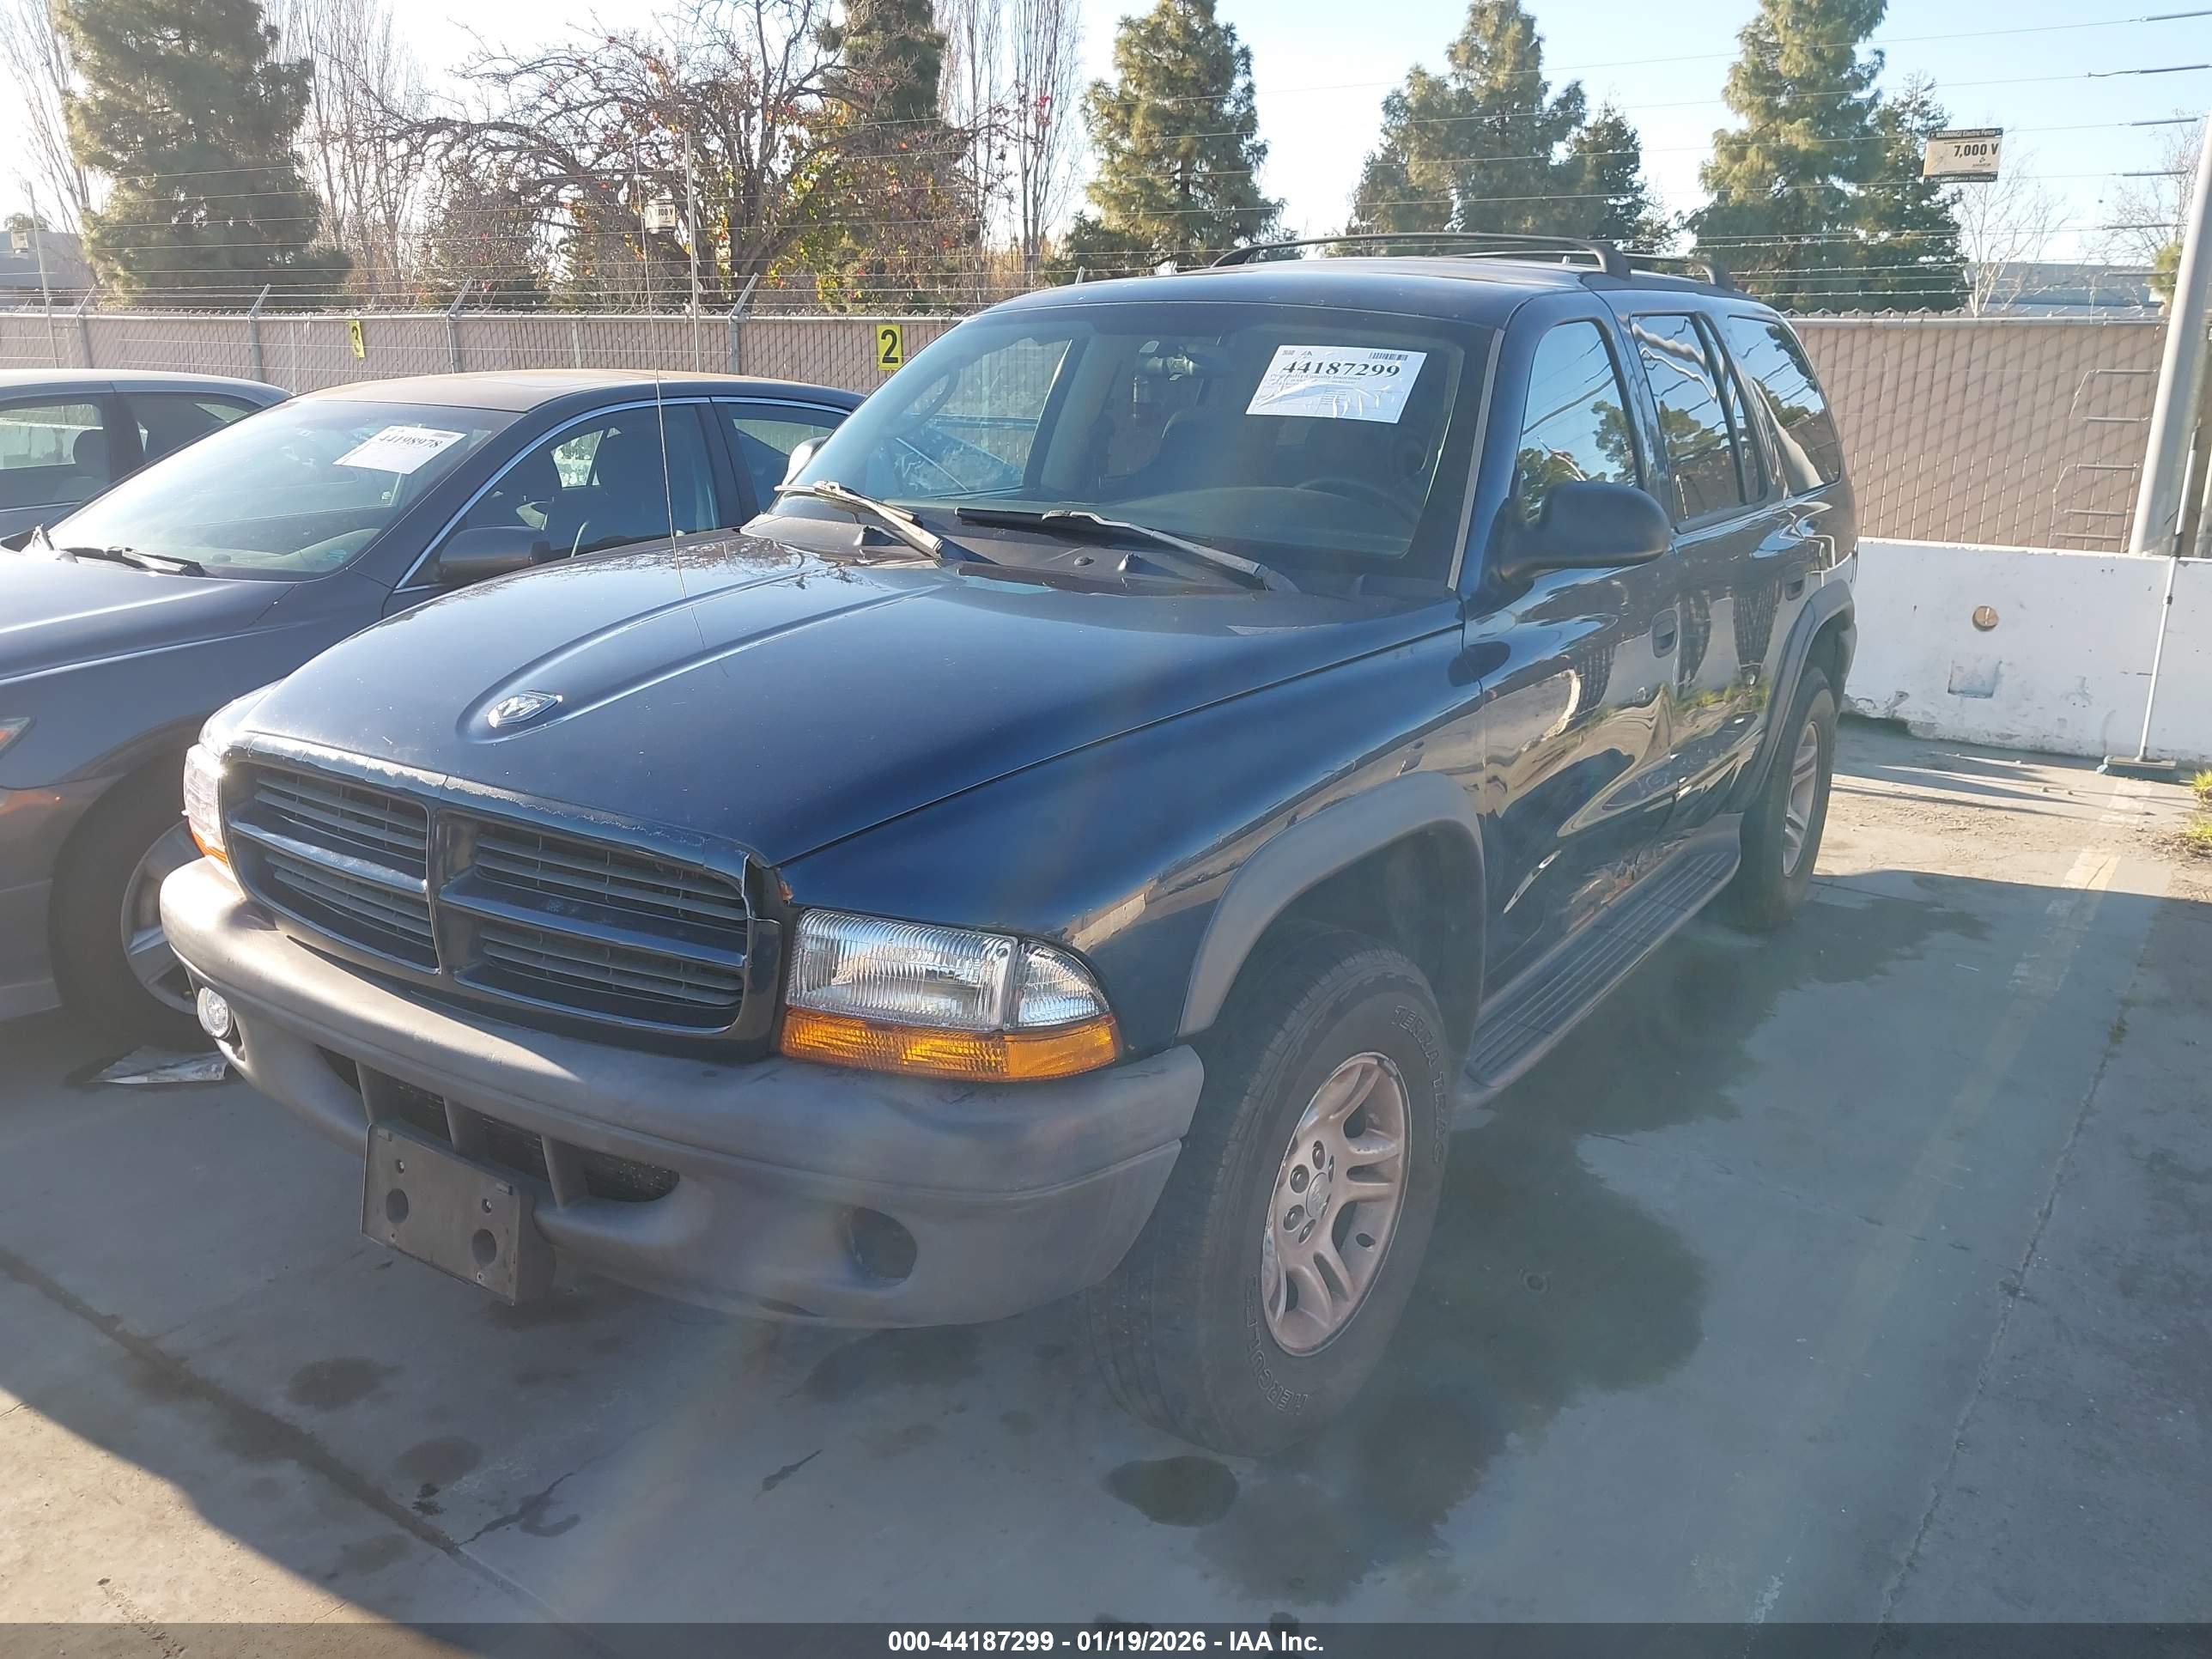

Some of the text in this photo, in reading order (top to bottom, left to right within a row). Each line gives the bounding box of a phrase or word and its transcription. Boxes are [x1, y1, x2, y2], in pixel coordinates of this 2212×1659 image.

[1954, 143, 1999, 158] 7,000 V
[351, 325, 361, 353] 3
[881, 329, 899, 363] 2
[1282, 361, 1401, 378] 44187299
[379, 434, 443, 448] 44198978
[1391, 1005, 1439, 1066] TERRA
